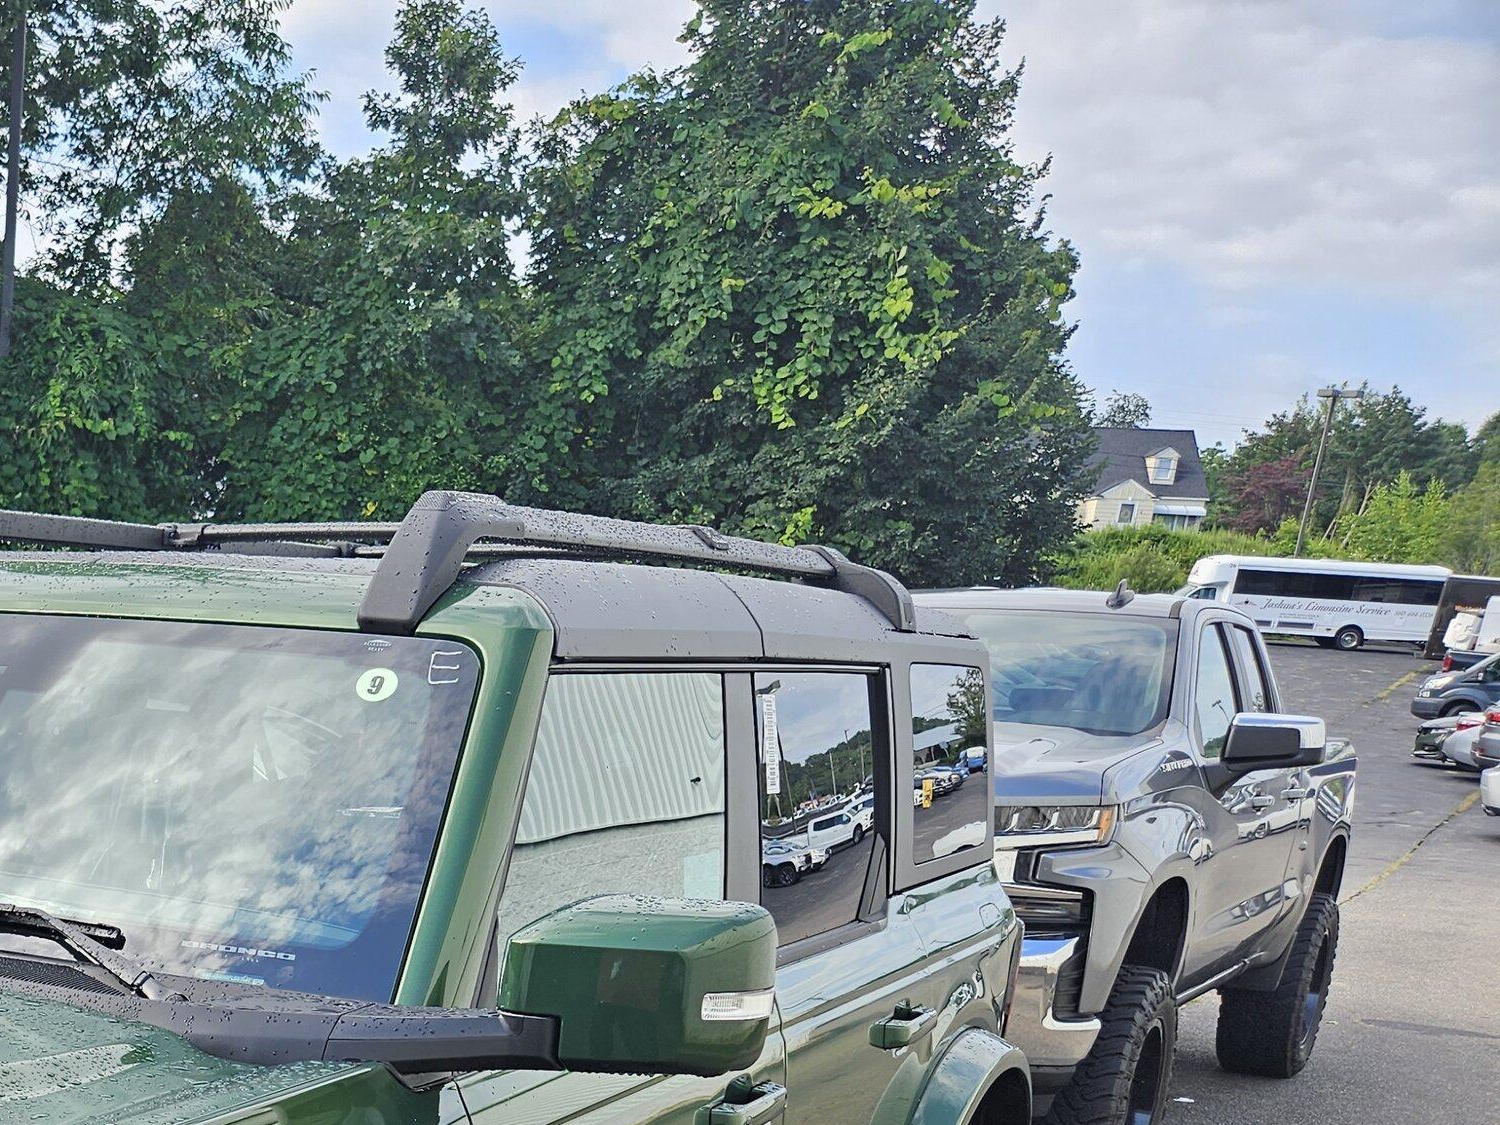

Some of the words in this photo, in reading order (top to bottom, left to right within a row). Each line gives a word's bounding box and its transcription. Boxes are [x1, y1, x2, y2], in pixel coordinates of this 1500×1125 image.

[1260, 598, 1302, 610] Joshua's
[1305, 601, 1354, 614] Limousine
[1357, 603, 1391, 616] Service
[428, 651, 462, 685] E
[367, 676, 385, 695] 9
[181, 939, 296, 961] BRONCO
